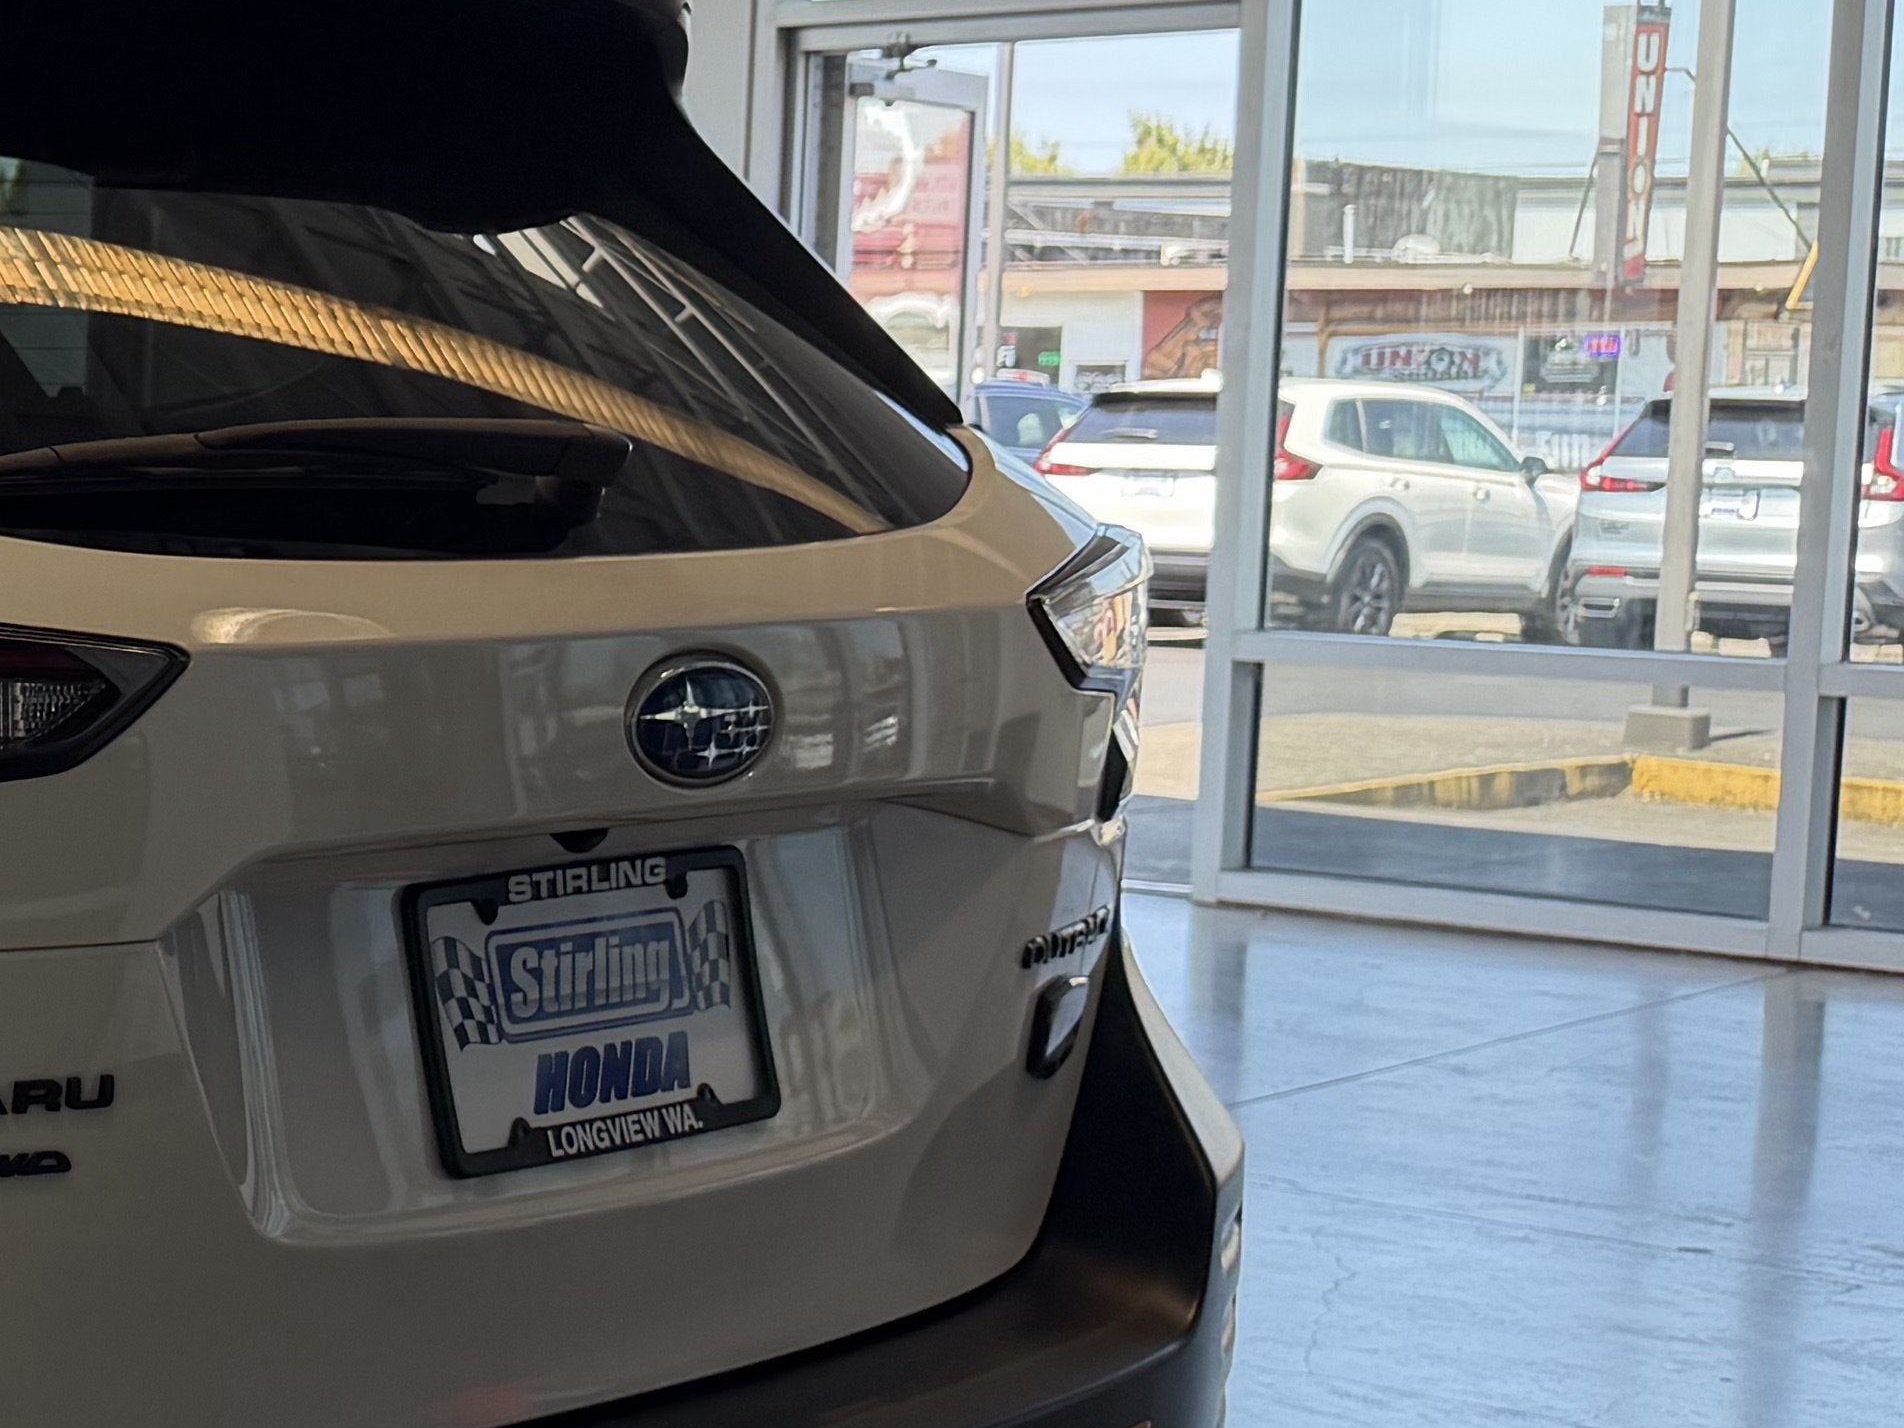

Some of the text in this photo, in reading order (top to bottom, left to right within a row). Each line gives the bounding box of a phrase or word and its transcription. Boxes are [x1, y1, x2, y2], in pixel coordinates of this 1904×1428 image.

[508, 856, 666, 902] STIRLING
[510, 934, 670, 1018] Stirling
[533, 1030, 691, 1115] HONDA
[547, 1102, 704, 1158] LONGVIEW WA.
